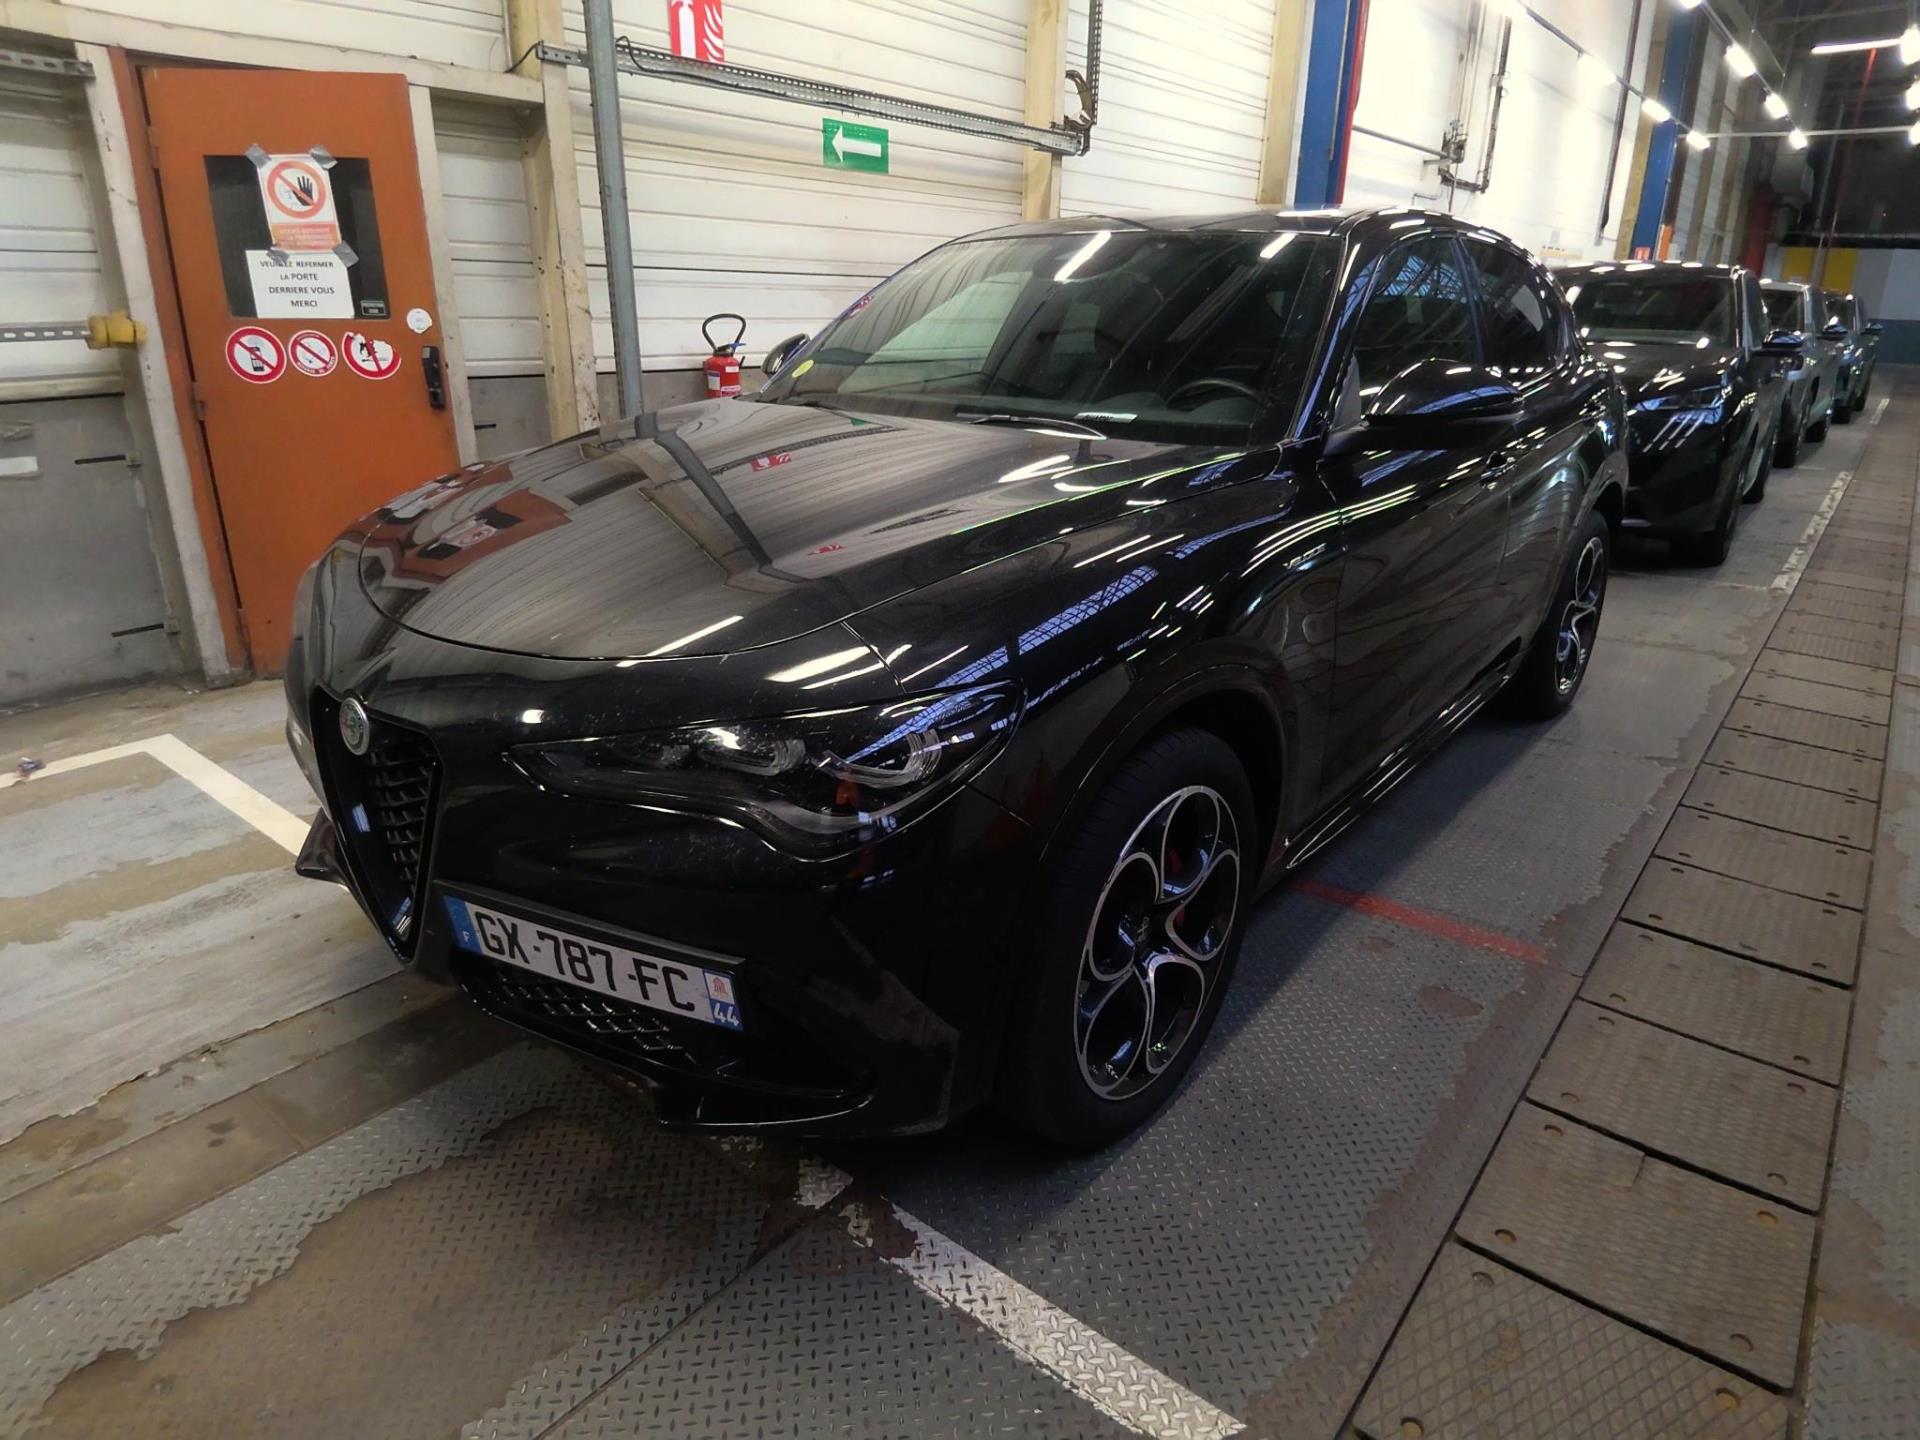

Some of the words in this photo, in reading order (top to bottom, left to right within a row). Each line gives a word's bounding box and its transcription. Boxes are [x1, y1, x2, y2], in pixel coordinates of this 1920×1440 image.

[291, 273, 319, 281] PORTE
[269, 286, 310, 294] DERRIERE
[311, 286, 335, 295] VOUS
[291, 300, 318, 308] MERCI
[463, 931, 470, 943] F
[475, 911, 695, 1012] GX-787-FC
[713, 1003, 740, 1026] 44
